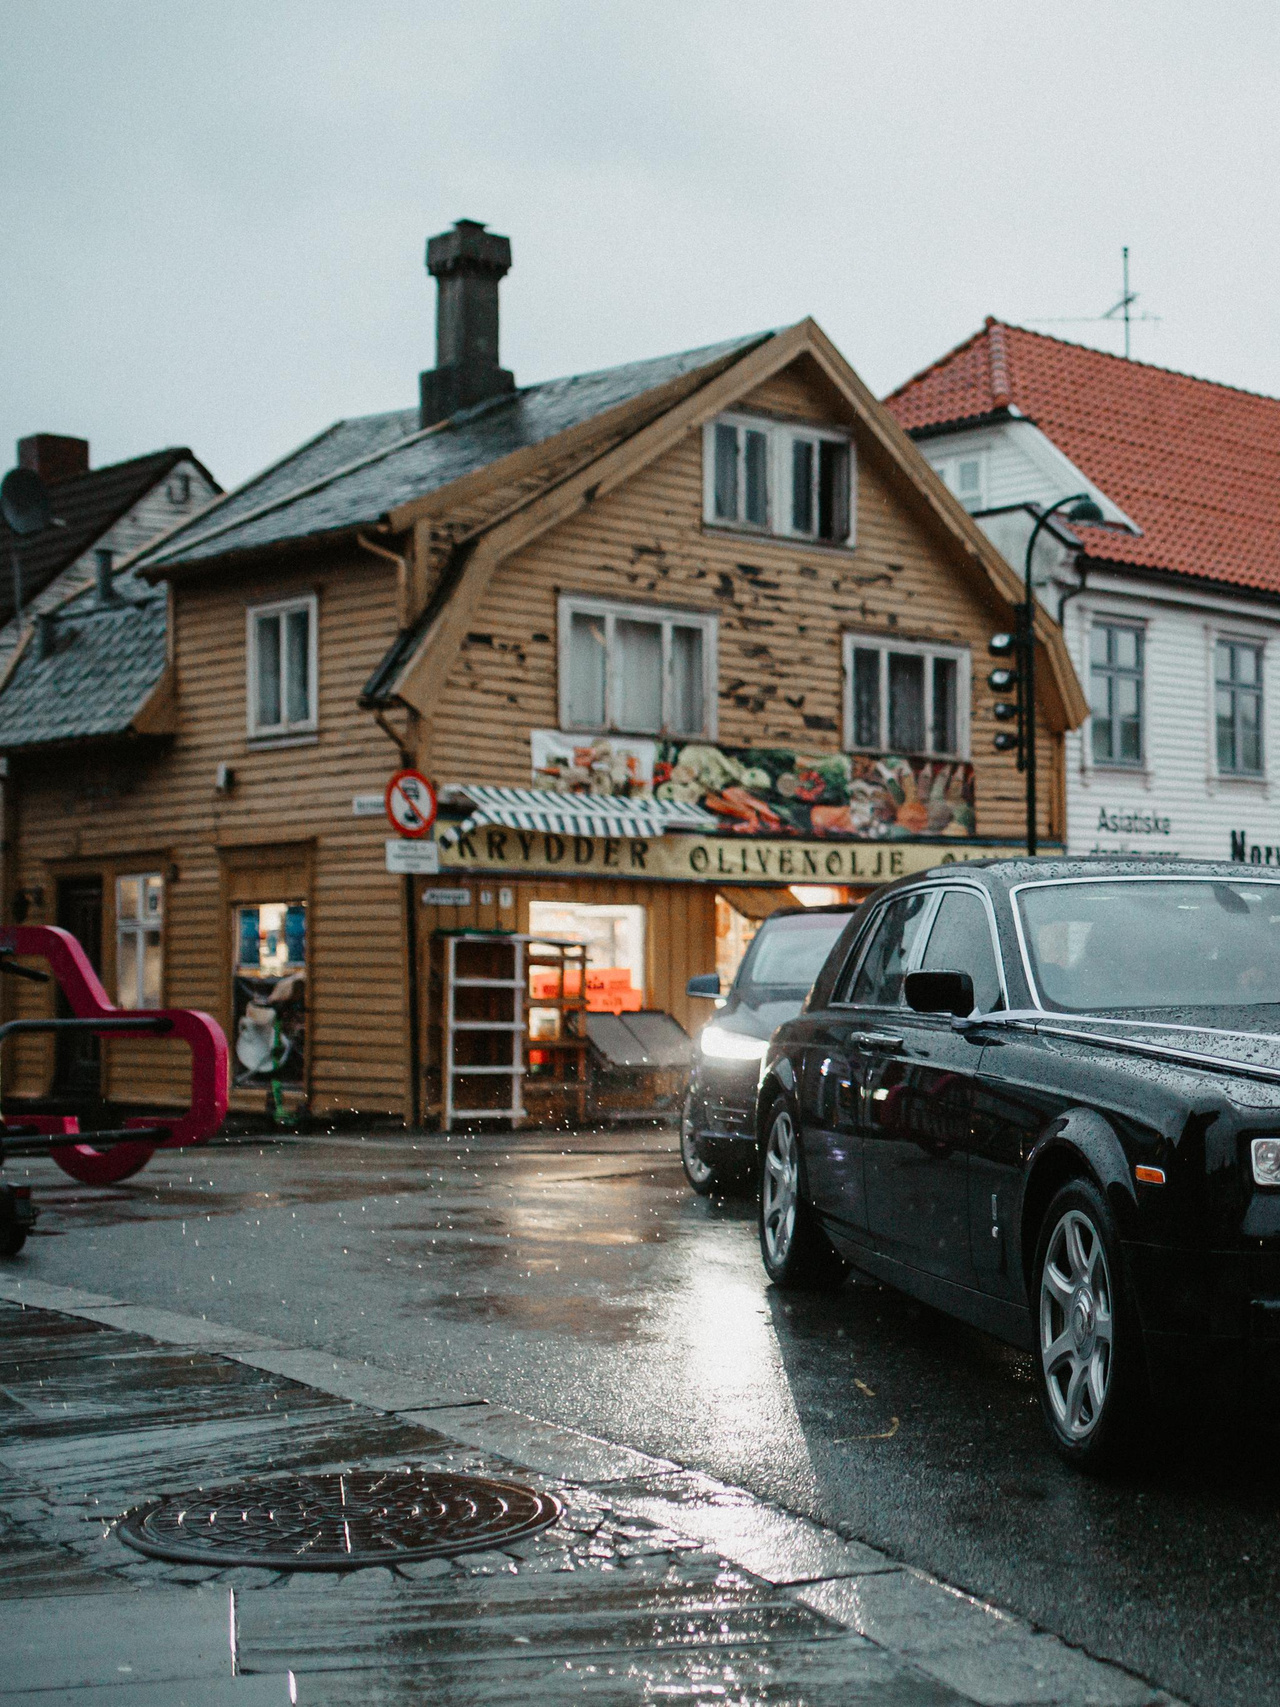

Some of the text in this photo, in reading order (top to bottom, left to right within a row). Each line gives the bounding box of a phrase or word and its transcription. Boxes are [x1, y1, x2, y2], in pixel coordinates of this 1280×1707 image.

[1098, 807, 1170, 835] Asiatiske
[458, 828, 904, 876] KRYDDER OLIVENOLJE
